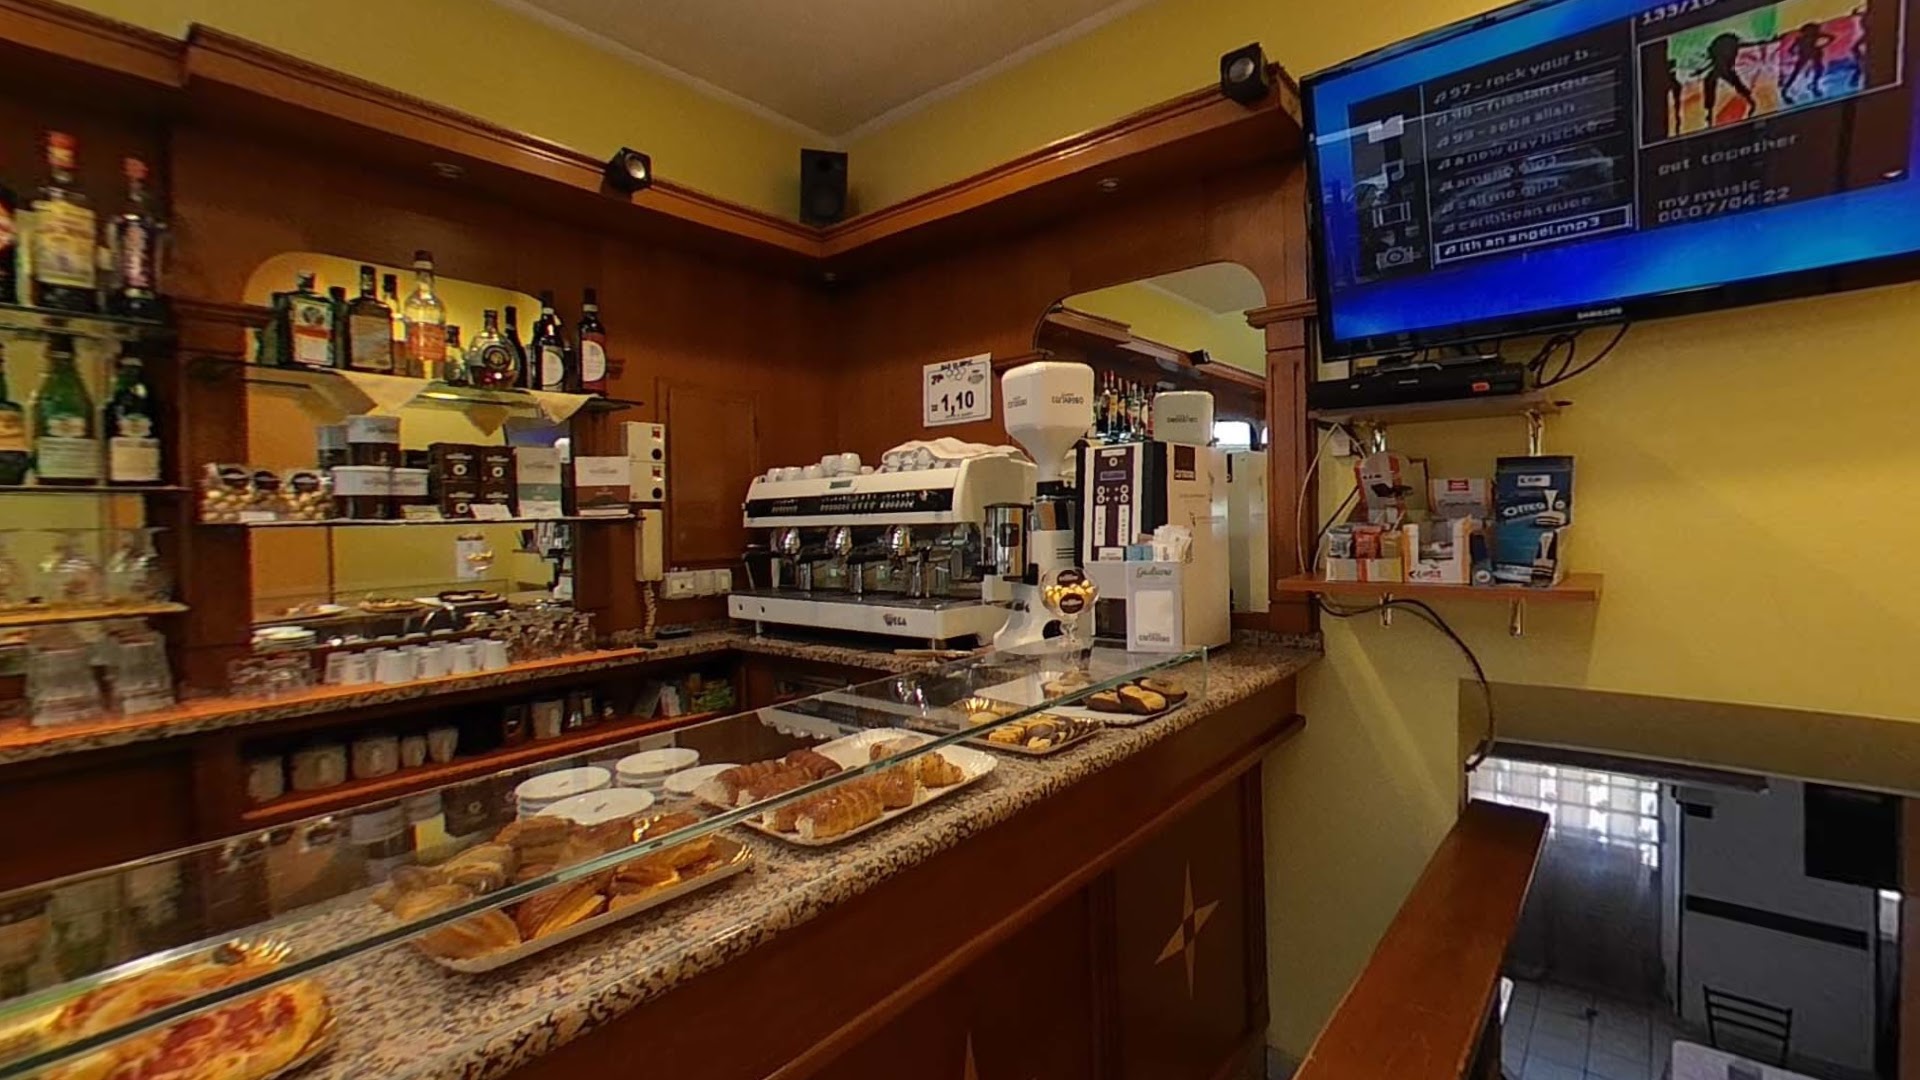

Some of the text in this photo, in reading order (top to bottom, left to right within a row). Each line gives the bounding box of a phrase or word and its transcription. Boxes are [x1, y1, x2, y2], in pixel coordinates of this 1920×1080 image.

[1487, 67, 1526, 87] rock
[1528, 54, 1571, 76] your
[1693, 180, 1761, 203] music
[1485, 235, 1506, 249] an
[1508, 215, 1600, 243] angel.mp3
[941, 391, 975, 416] 1,10
